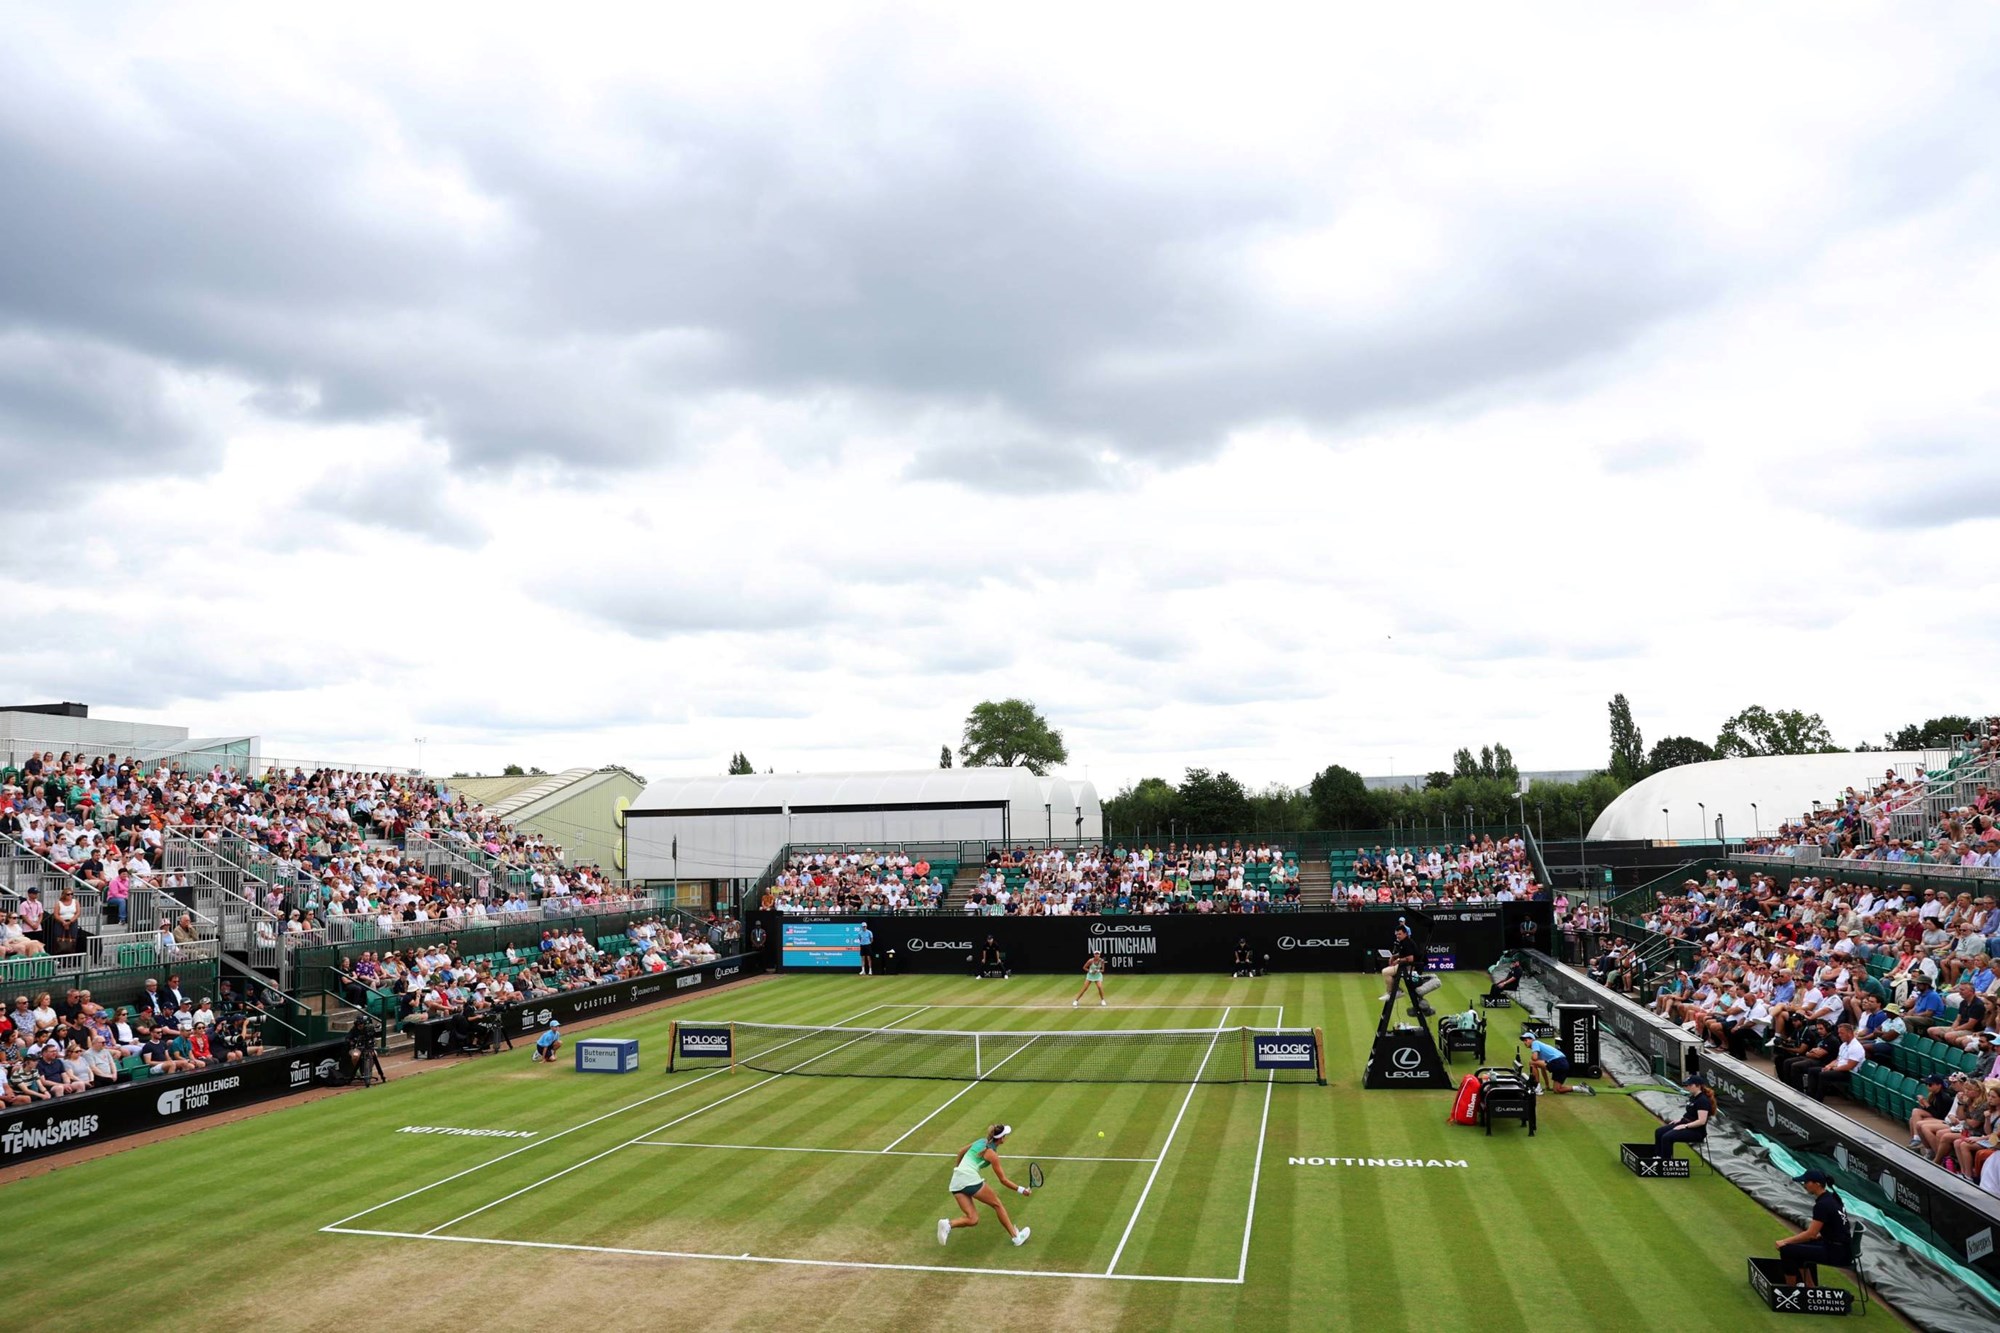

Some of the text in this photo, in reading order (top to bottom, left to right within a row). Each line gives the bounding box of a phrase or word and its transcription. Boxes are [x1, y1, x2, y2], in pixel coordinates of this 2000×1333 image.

[1107, 924, 1152, 933] LEXUS
[925, 941, 973, 950] LEXUS
[1087, 936, 1157, 954] NOTTINGHAM
[1297, 938, 1350, 947] LEXUS
[1111, 956, 1134, 968] OPEN
[721, 966, 740, 976] LEXUS
[583, 994, 617, 1009] CASTORE
[522, 1015, 534, 1026] YOUTH
[683, 1035, 728, 1044] HOLOGIC
[1573, 1017, 1585, 1052] BRITA
[584, 1048, 616, 1057] Butternut
[1258, 1044, 1311, 1054] HOLOGIC
[290, 1067, 310, 1083] YOUTH
[1385, 1070, 1430, 1078] LEXUS
[186, 1076, 240, 1098] CHALLENGER
[1717, 1076, 1745, 1103] FAGE
[186, 1094, 209, 1109] TOUR
[1466, 1093, 1477, 1118] Wilson
[395, 1125, 539, 1138] NOTTINGHAM
[1288, 1157, 1469, 1168] NOTTINGHAM
[1807, 1289, 1844, 1299] CREW
[1808, 1304, 1845, 1312] COMPANY
